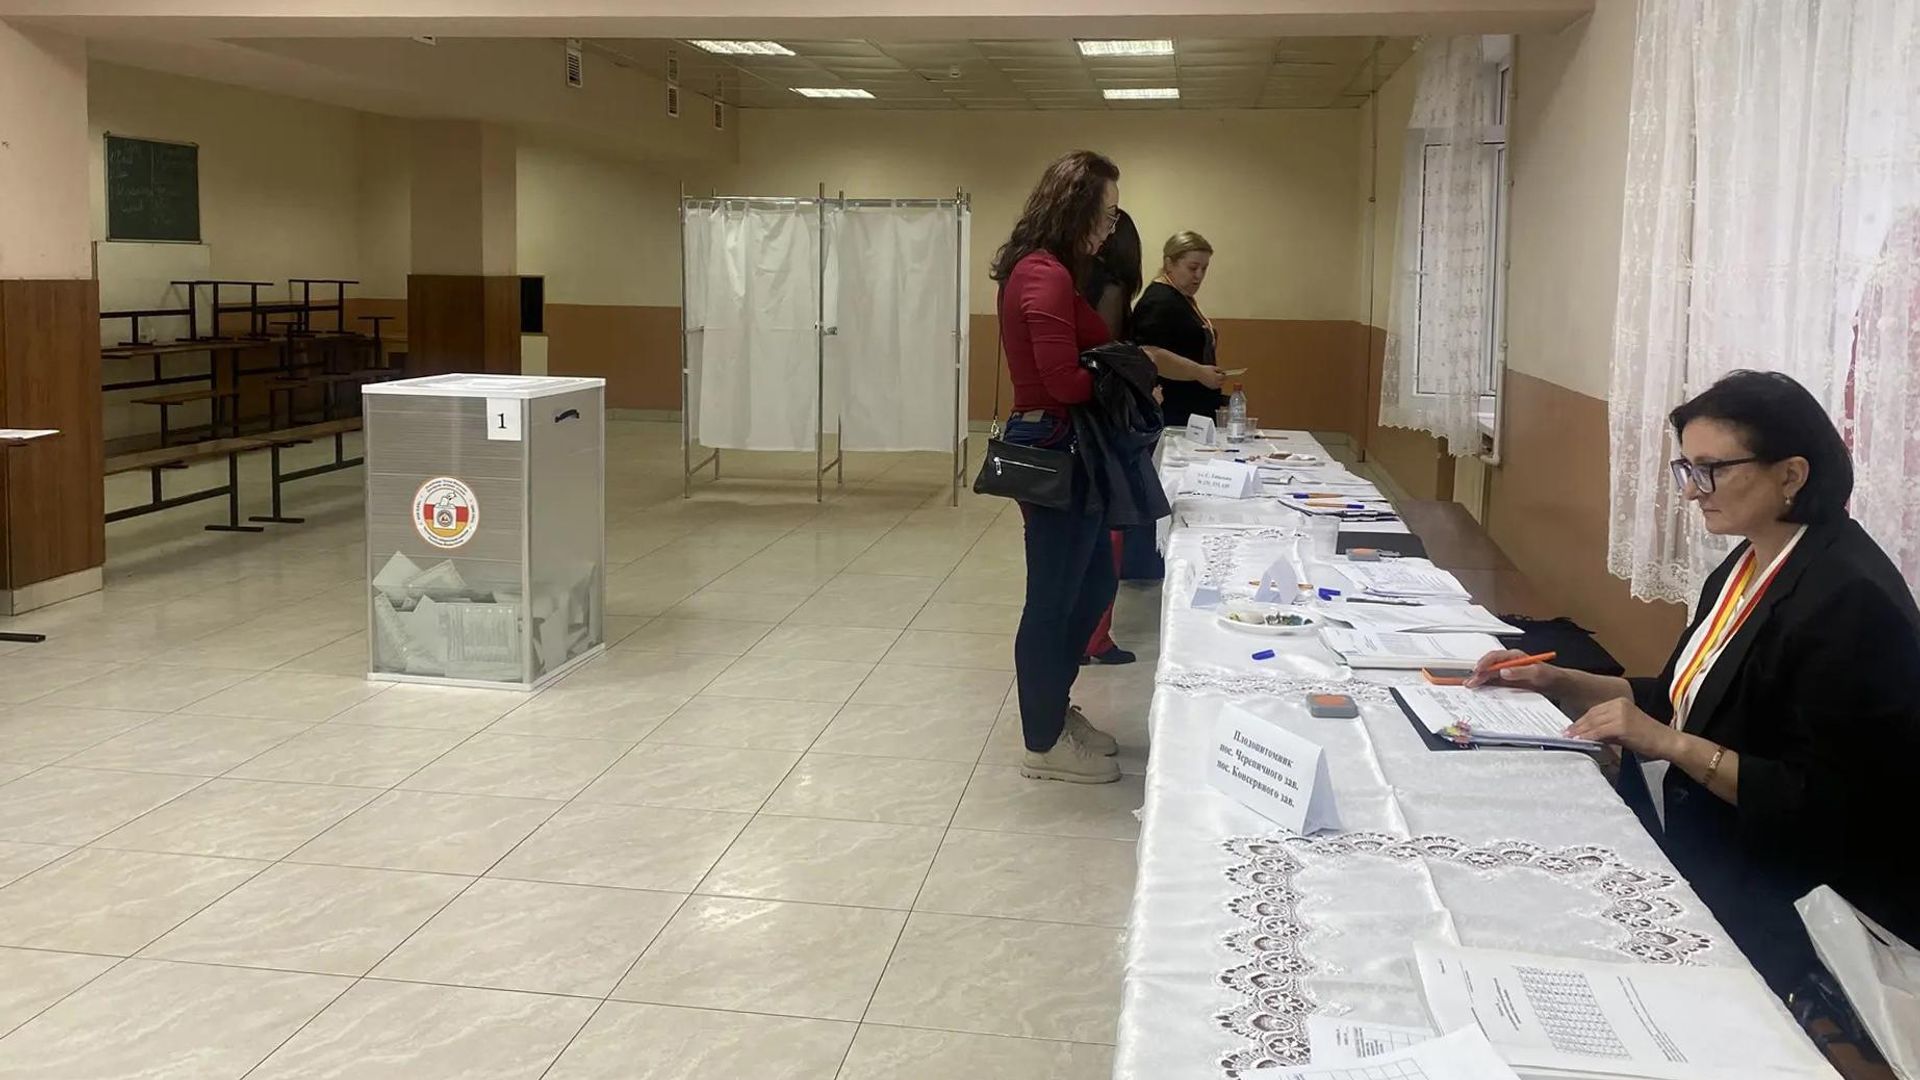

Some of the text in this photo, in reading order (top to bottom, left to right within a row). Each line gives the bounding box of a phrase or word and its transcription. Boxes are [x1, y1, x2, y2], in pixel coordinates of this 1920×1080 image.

[498, 413, 507, 429] 1
[1220, 744, 1298, 790] пос. Черепичного зав.
[1233, 730, 1294, 768] Плодопитомник
[1217, 761, 1294, 807] пос. Консервного зав.
